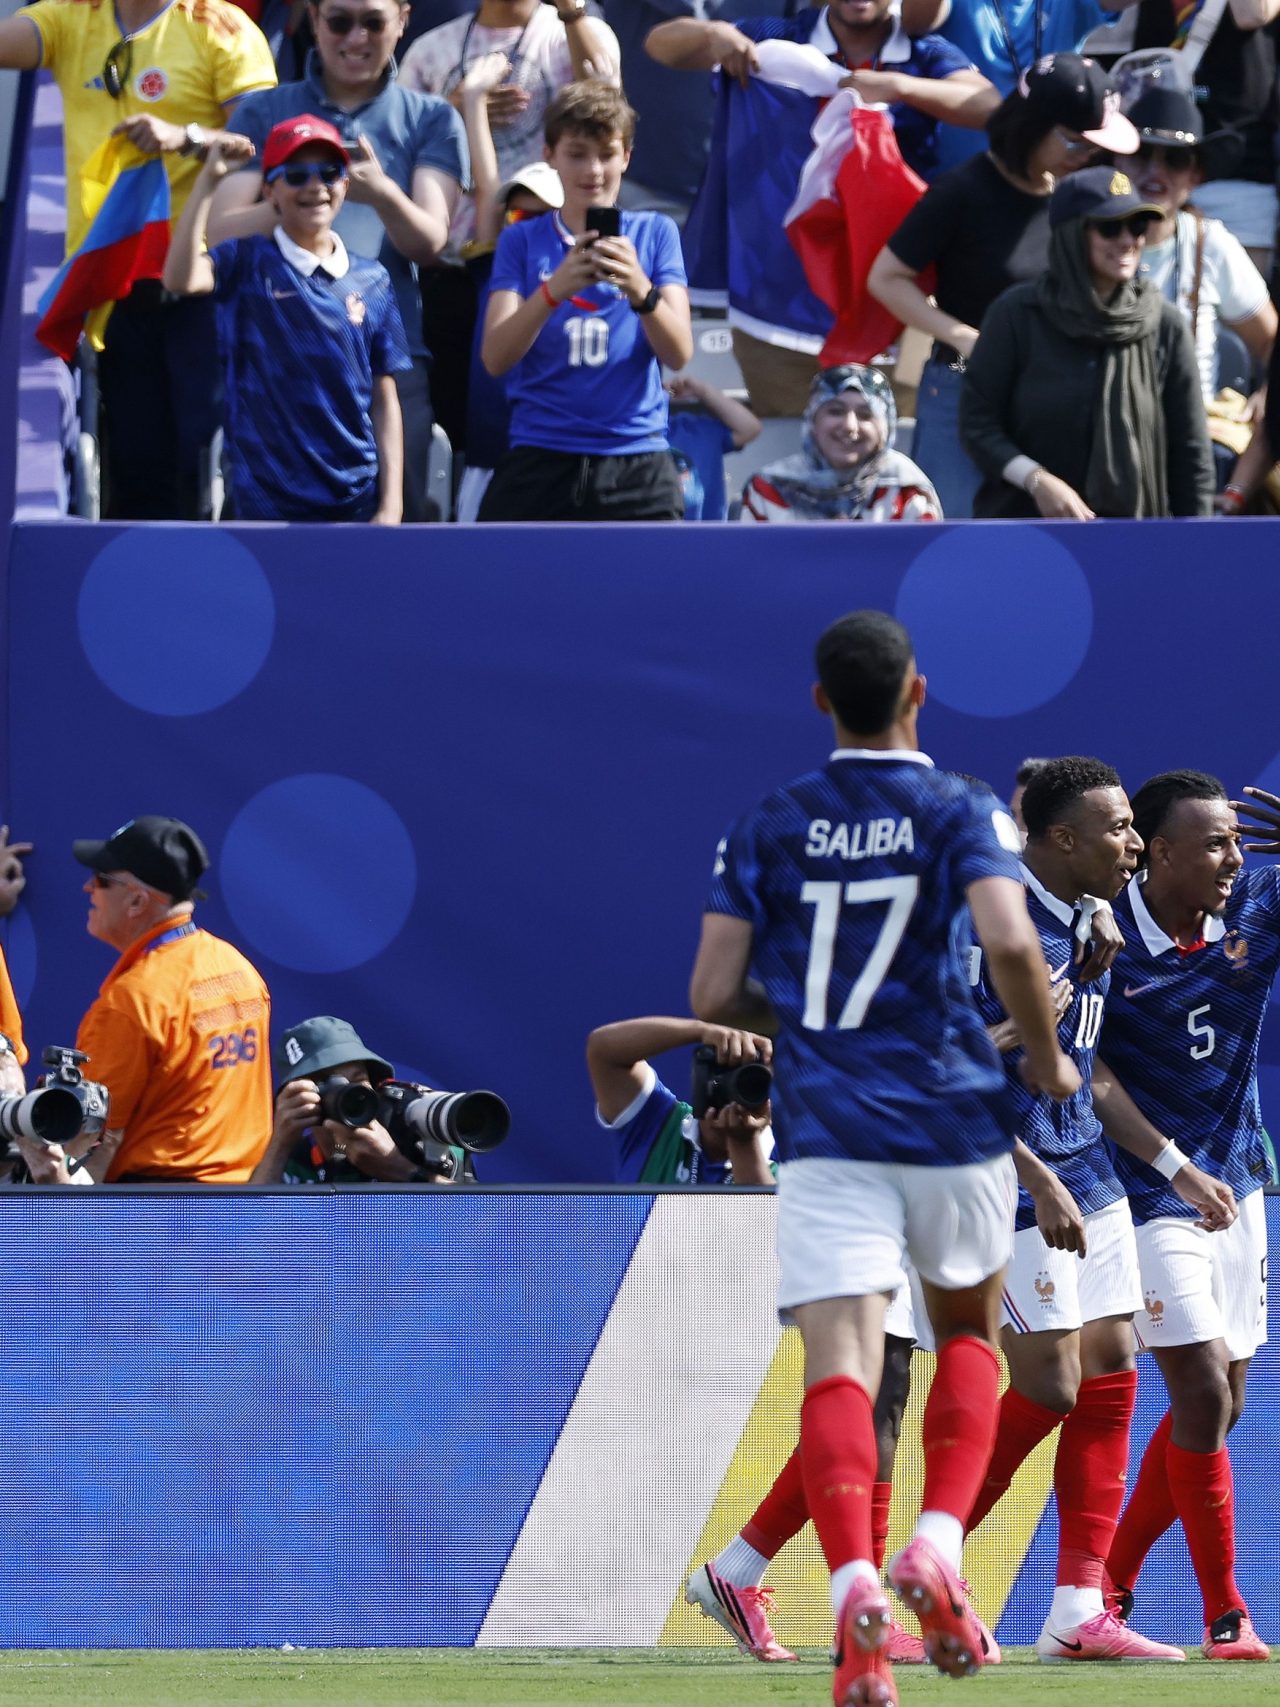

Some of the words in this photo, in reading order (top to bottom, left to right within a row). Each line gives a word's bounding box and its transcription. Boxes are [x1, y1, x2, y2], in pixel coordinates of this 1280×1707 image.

[563, 316, 609, 367] 10
[805, 817, 915, 860] SALIBA
[800, 874, 920, 1031] 17
[1075, 994, 1104, 1048] 10
[1187, 1003, 1216, 1060] 5
[208, 1028, 257, 1070] 296
